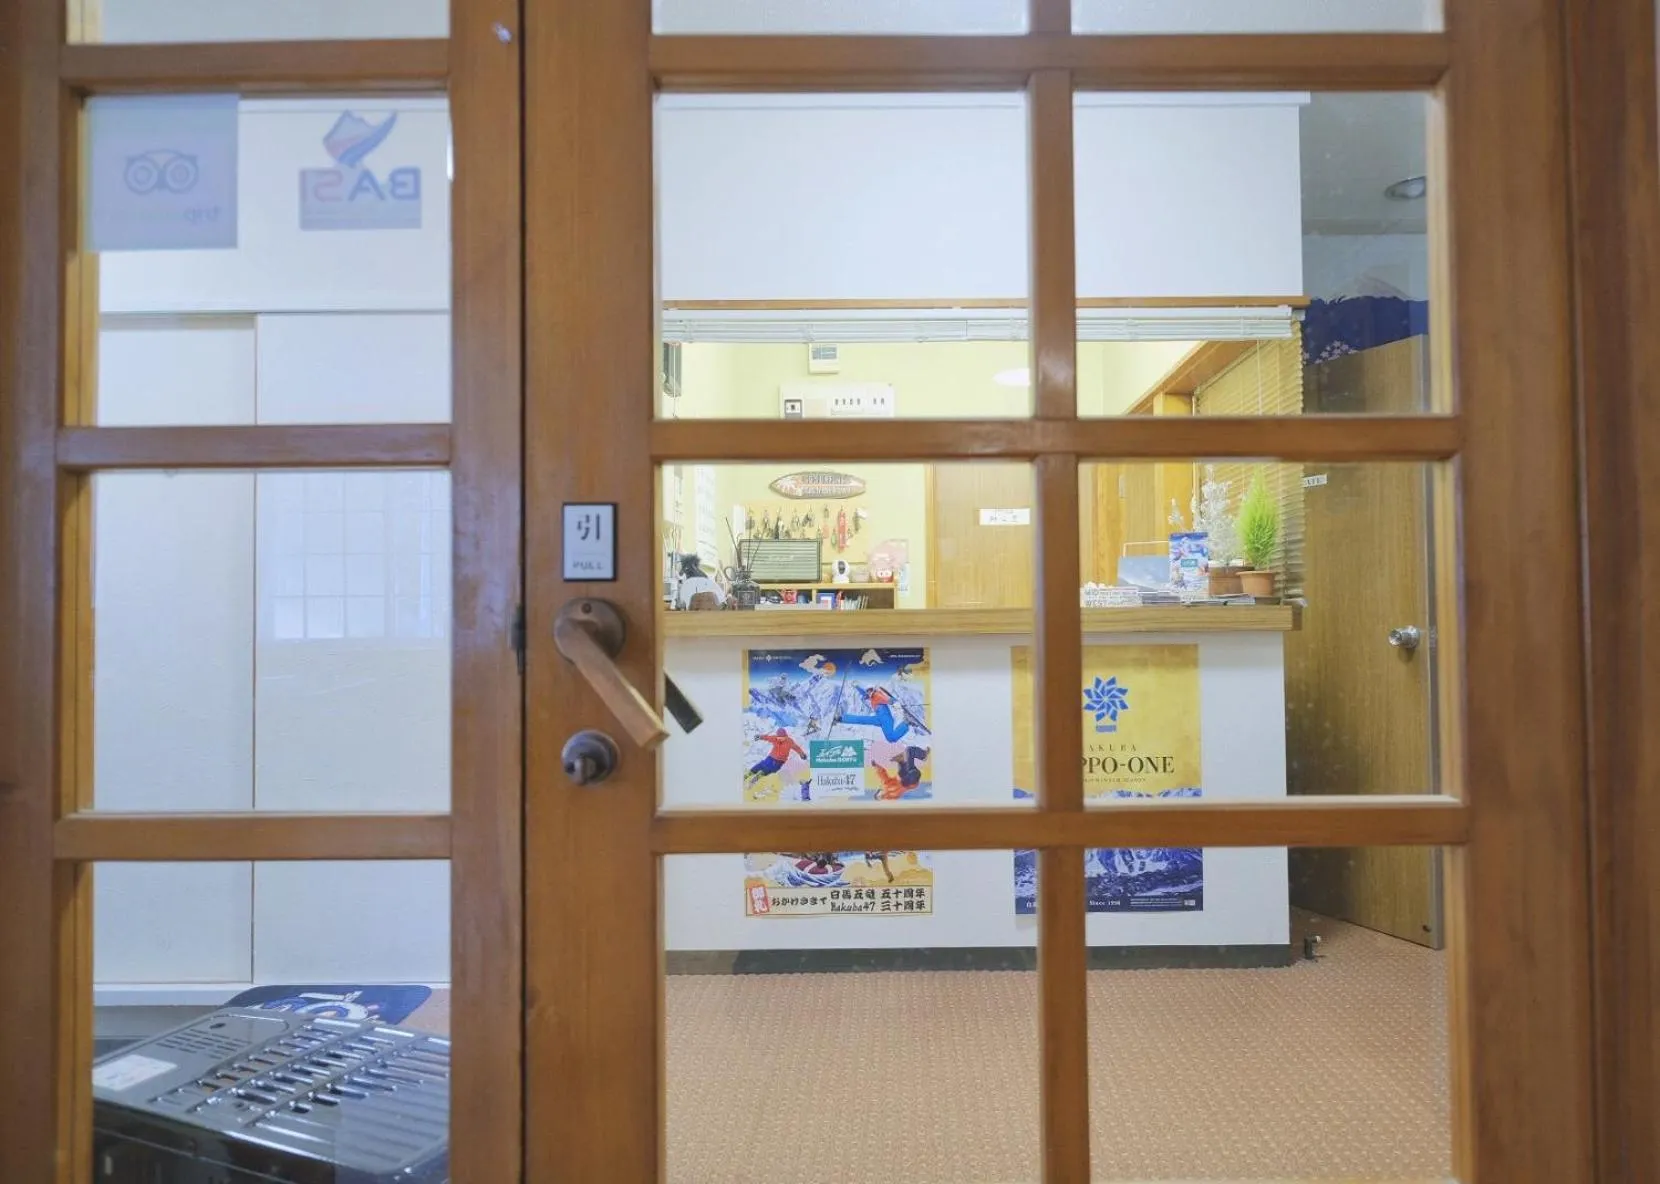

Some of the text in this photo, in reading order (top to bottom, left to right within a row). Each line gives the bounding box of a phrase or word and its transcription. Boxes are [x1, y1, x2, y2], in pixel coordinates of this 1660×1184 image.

[577, 512, 601, 541] 引
[572, 561, 604, 571] PULL
[1089, 743, 1137, 752] AKUBA
[1081, 756, 1174, 774] PPO-ONE
[881, 888, 926, 900] 五十周年
[881, 900, 926, 912] 三十周年
